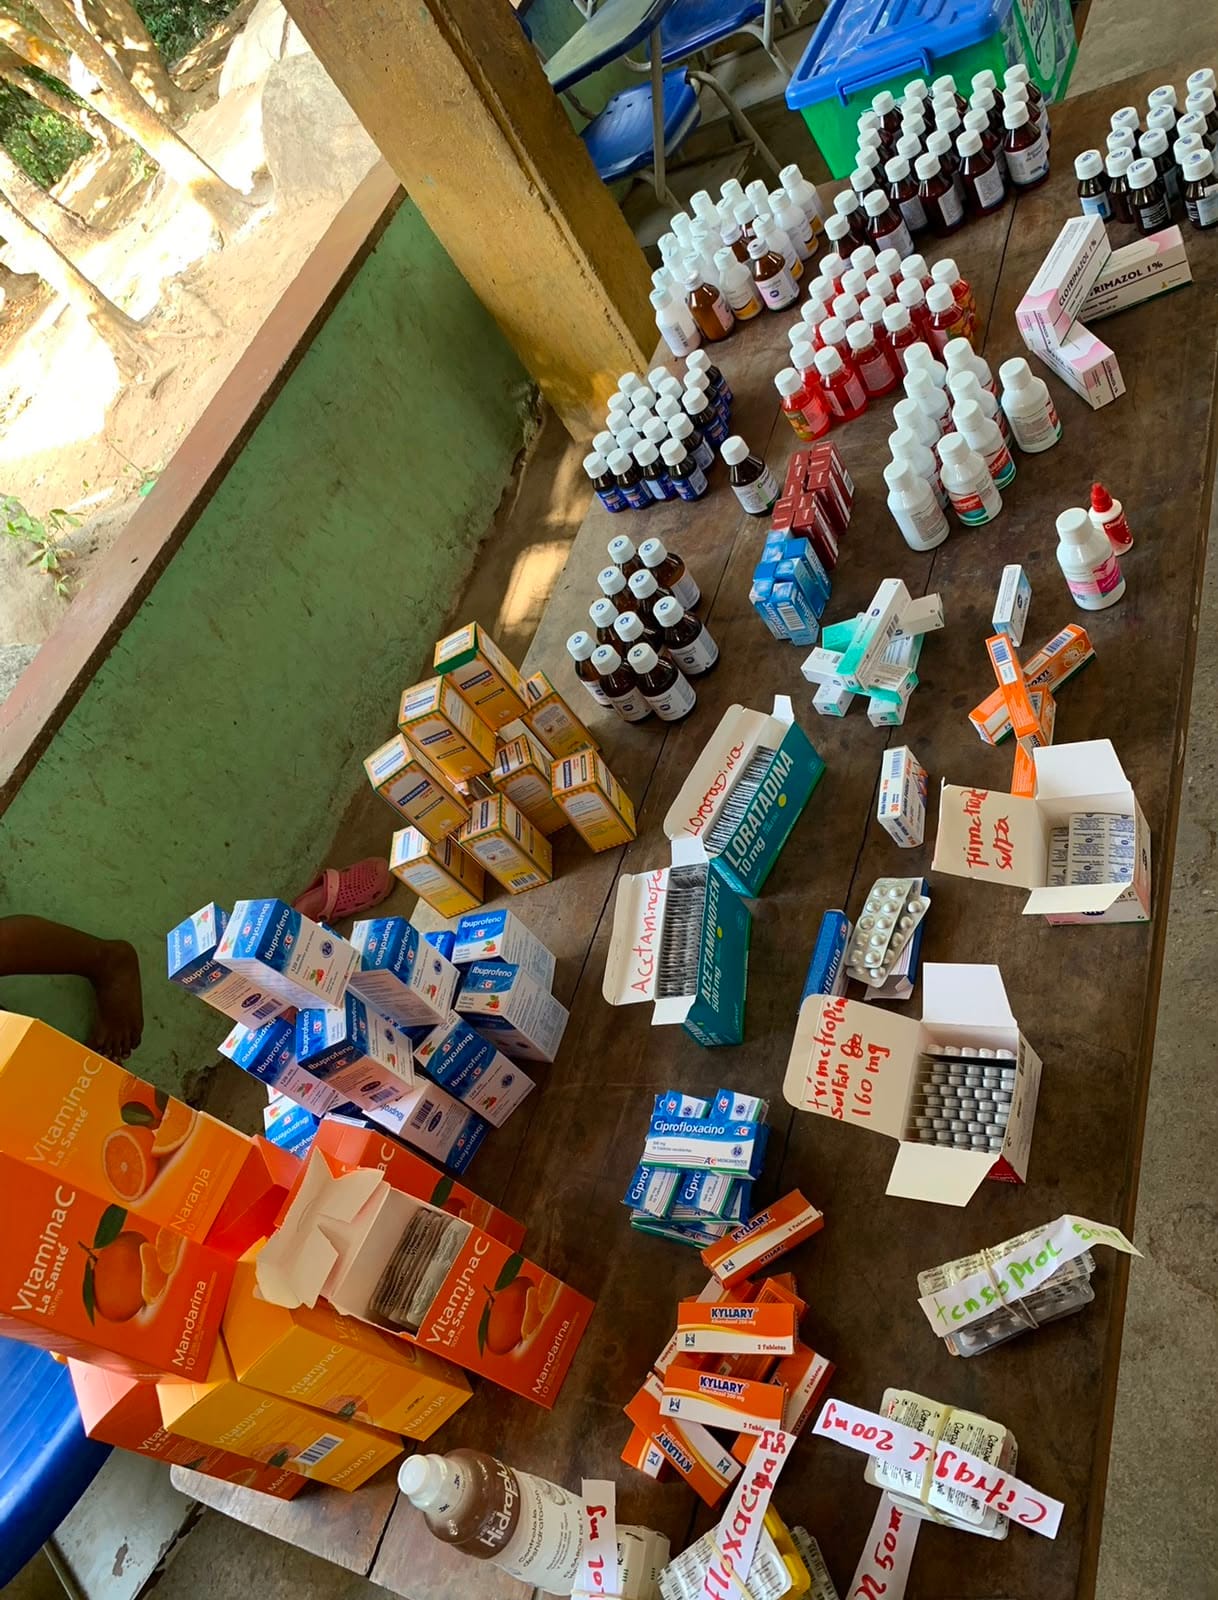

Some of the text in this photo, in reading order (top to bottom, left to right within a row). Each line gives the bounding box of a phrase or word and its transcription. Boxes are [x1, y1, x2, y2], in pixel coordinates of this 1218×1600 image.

[1058, 252, 1089, 307] CLOTRIMAZOL
[1090, 269, 1143, 297] RIMAZOL
[725, 749, 794, 868] LORATADINA
[738, 837, 766, 878] 10 mg
[245, 903, 271, 953] Ibuprofeno
[265, 908, 290, 961] Ibuprofeno
[375, 921, 394, 966] Ibuprofeno
[462, 915, 502, 929] Ibuprofeno
[393, 926, 411, 972] Ibuprofeno
[182, 960, 217, 985] Ibuprofe
[472, 967, 513, 979] Ibuprofeno
[823, 948, 842, 995] nitidina
[256, 1028, 293, 1074] Ibuprofeno
[308, 1045, 354, 1071] Ibuprofeno
[437, 1032, 475, 1075] Ibuprofeno
[450, 1045, 488, 1088] Ibuprofeno
[852, 1079, 873, 1117] 160
[454, 1123, 484, 1169] Ibuprofeno
[653, 1120, 726, 1135] Ciprofloxacino
[48, 1151, 65, 1168] La
[170, 1166, 213, 1233] Naranja
[732, 1211, 771, 1242] KYLLARY
[35, 1242, 69, 1315] La Santé
[172, 1280, 207, 1367] Mandarina
[442, 1287, 476, 1347] La Santé
[710, 1307, 755, 1319] KYLLARY
[532, 1319, 570, 1395] Mandarina
[699, 1375, 745, 1394] KYLLARY
[403, 1395, 447, 1433] Naranja
[655, 1432, 693, 1473] KYLLARY
[518, 1519, 538, 1563] Controla
